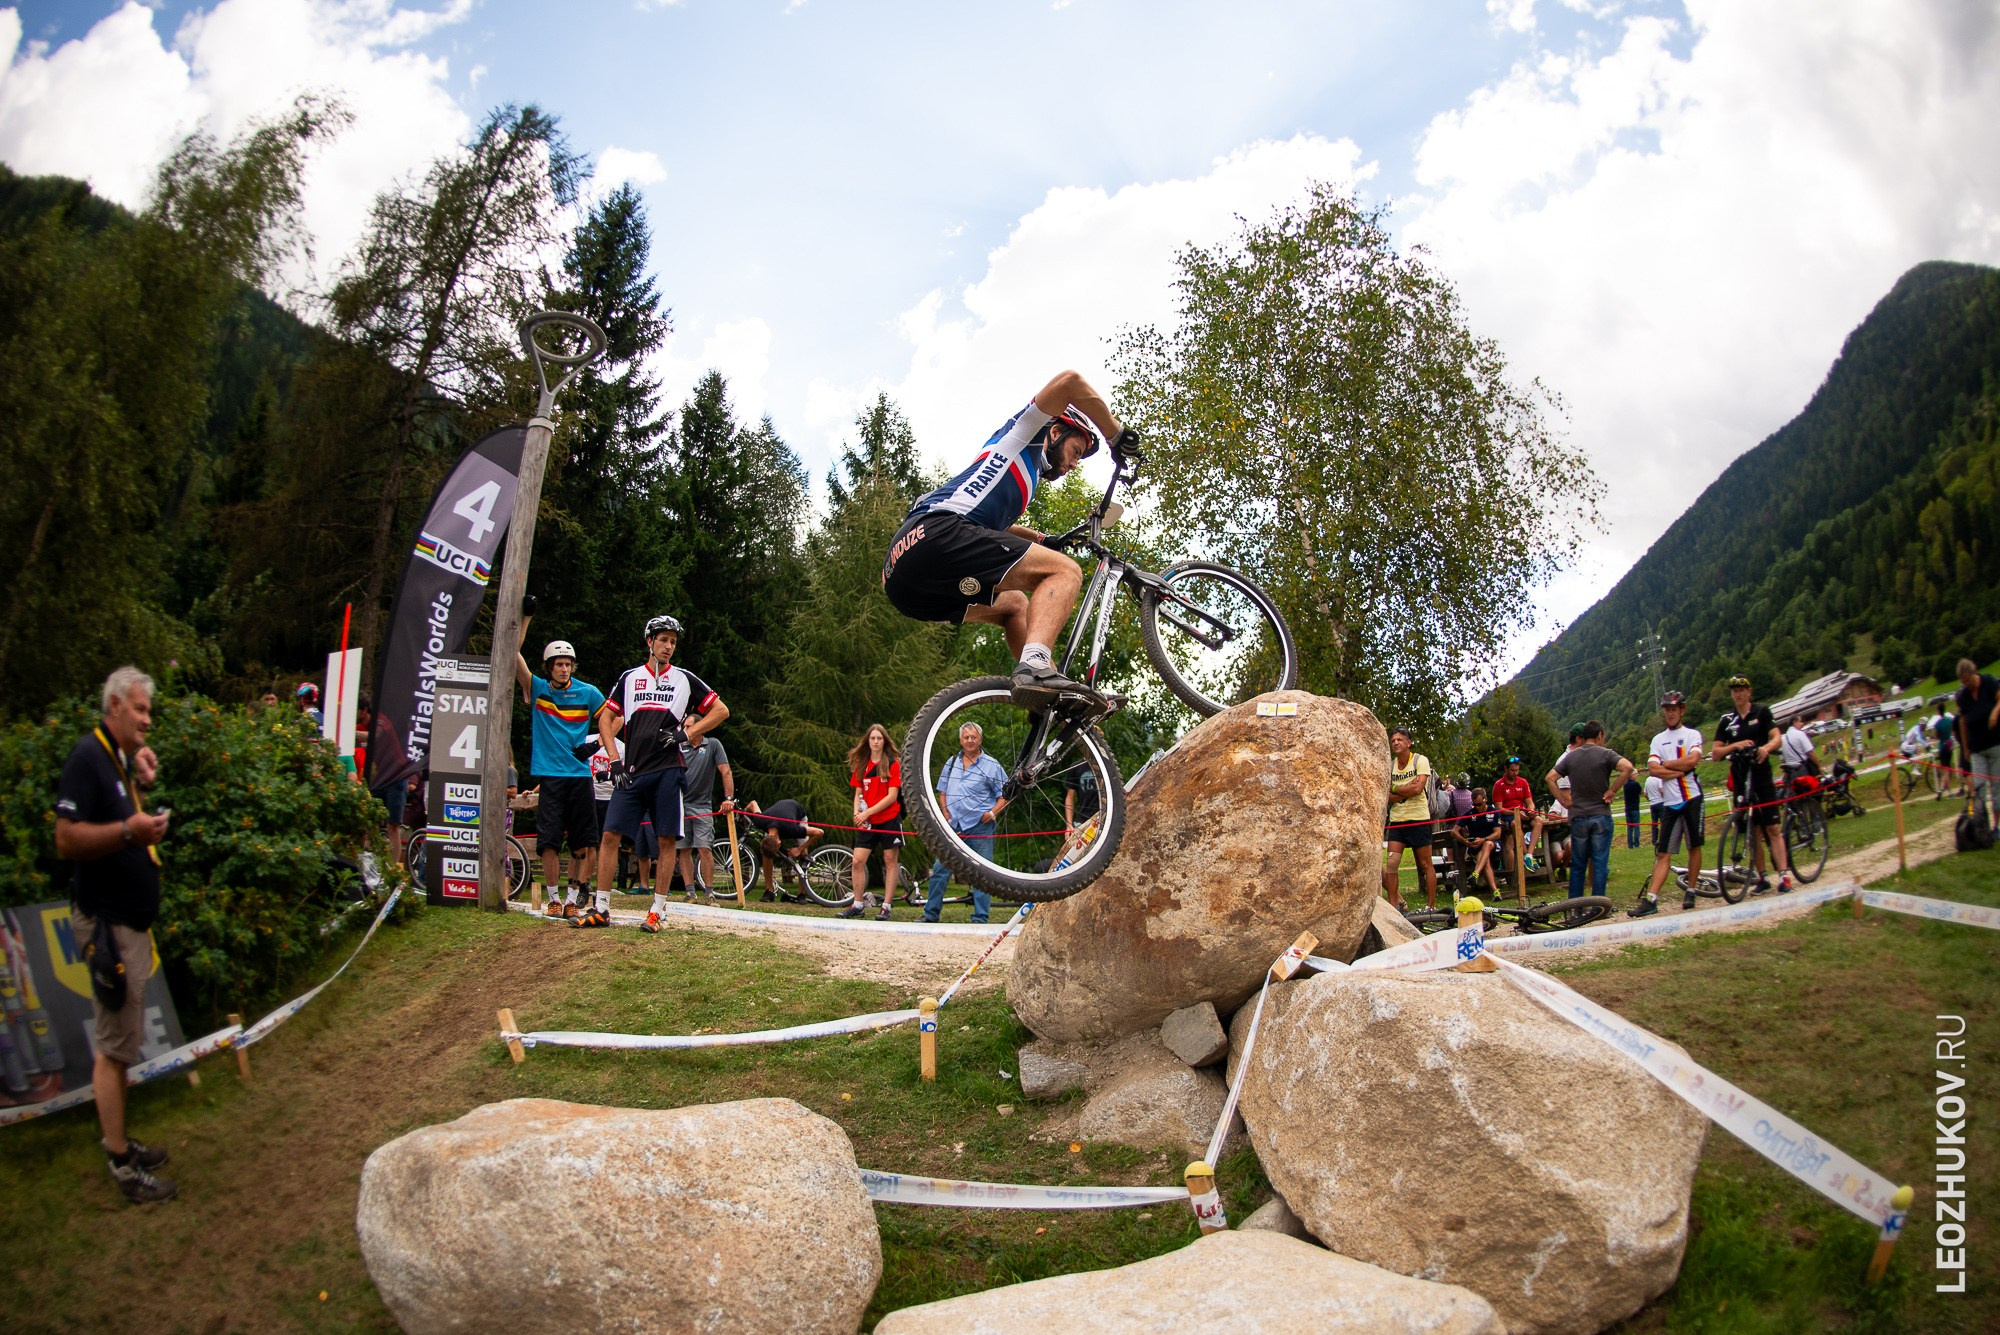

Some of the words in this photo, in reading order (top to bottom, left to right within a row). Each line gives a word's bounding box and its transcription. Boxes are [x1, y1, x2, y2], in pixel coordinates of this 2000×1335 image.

[963, 453, 1008, 498] FRANCE
[453, 480, 501, 543] 4
[435, 544, 472, 573] UCI
[440, 660, 457, 669] UCI
[407, 592, 453, 763] #TrialsWorlds
[438, 694, 487, 715] STAR
[634, 692, 674, 702] AUSTRIA
[450, 725, 482, 768] 4
[455, 787, 478, 799] UCI
[451, 830, 474, 841] UCI
[453, 862, 476, 874] UCI
